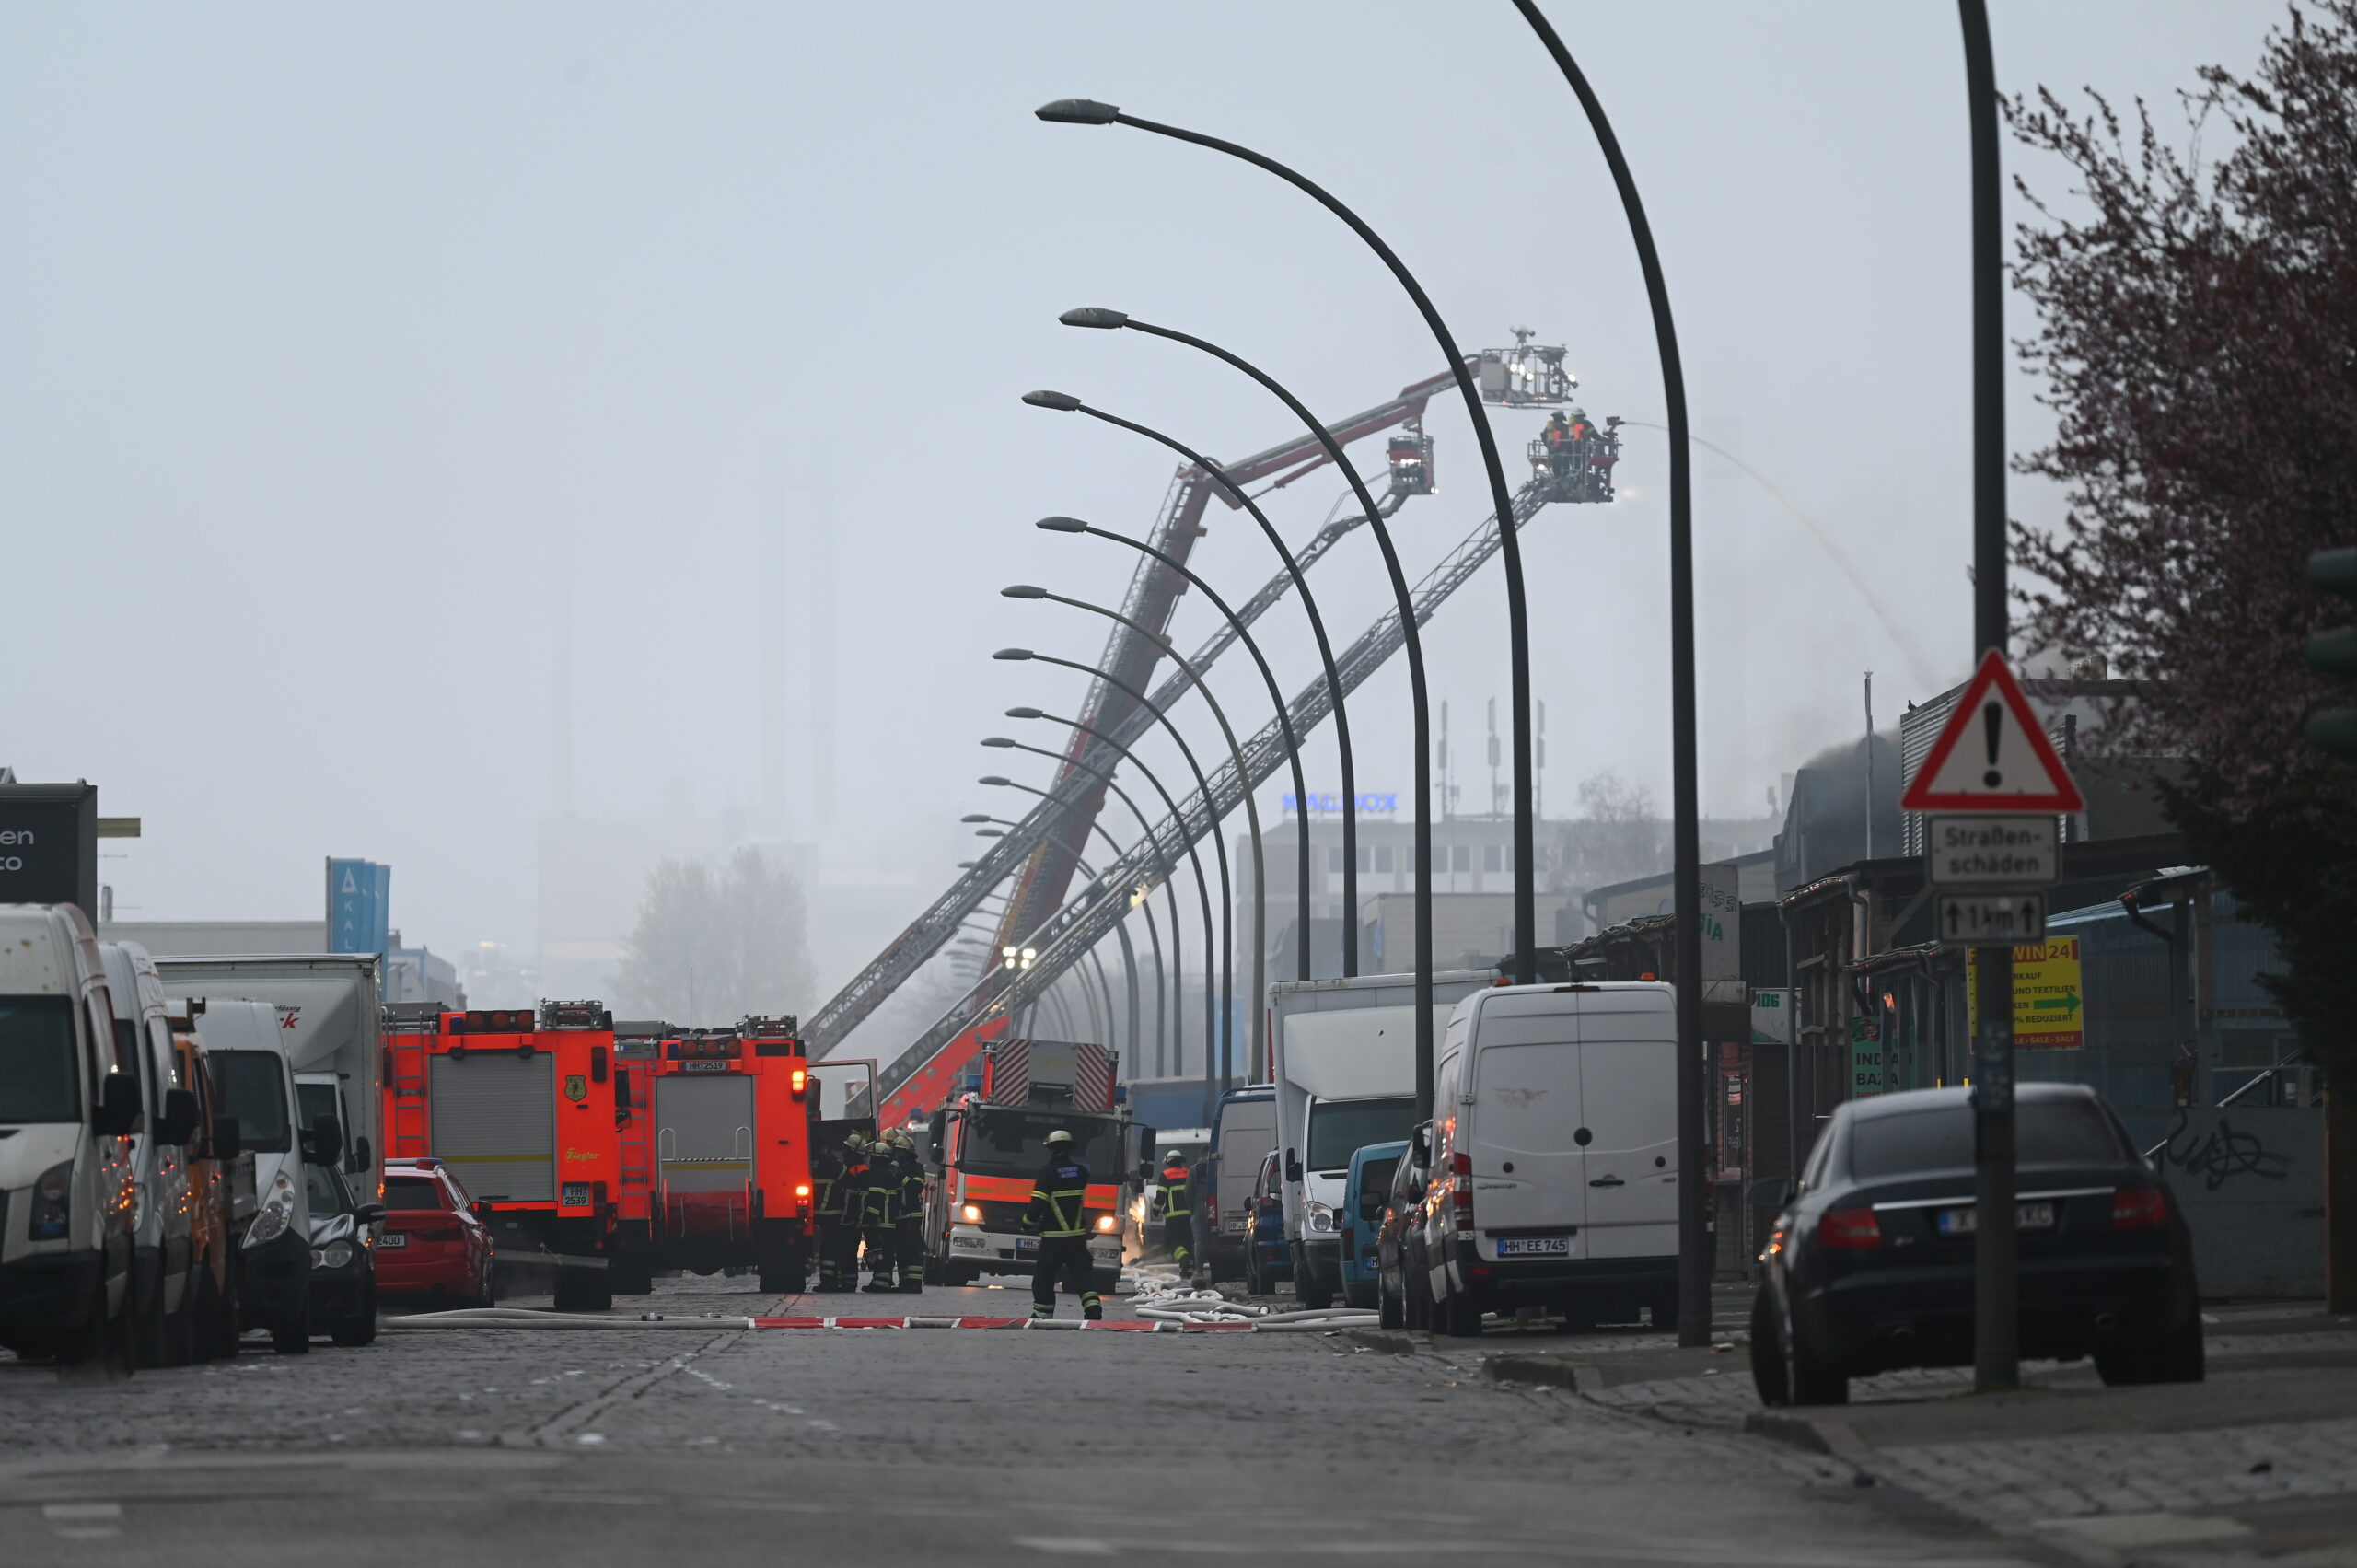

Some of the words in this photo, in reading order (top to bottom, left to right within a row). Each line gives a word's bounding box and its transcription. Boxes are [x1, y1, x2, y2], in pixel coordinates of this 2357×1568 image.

[1945, 826, 2042, 847] Straßen-
[1949, 854, 2039, 875] schäden
[1969, 905, 1978, 931] 1
[2049, 944, 2070, 958] 24
[2033, 985, 2076, 993] TEXTILIEN
[2026, 1015, 2073, 1023] REDUZIERT
[571, 1187, 582, 1195] HH
[1504, 1241, 1520, 1252] HH
[1527, 1240, 1542, 1252] EE
[1545, 1239, 1566, 1251] 745
